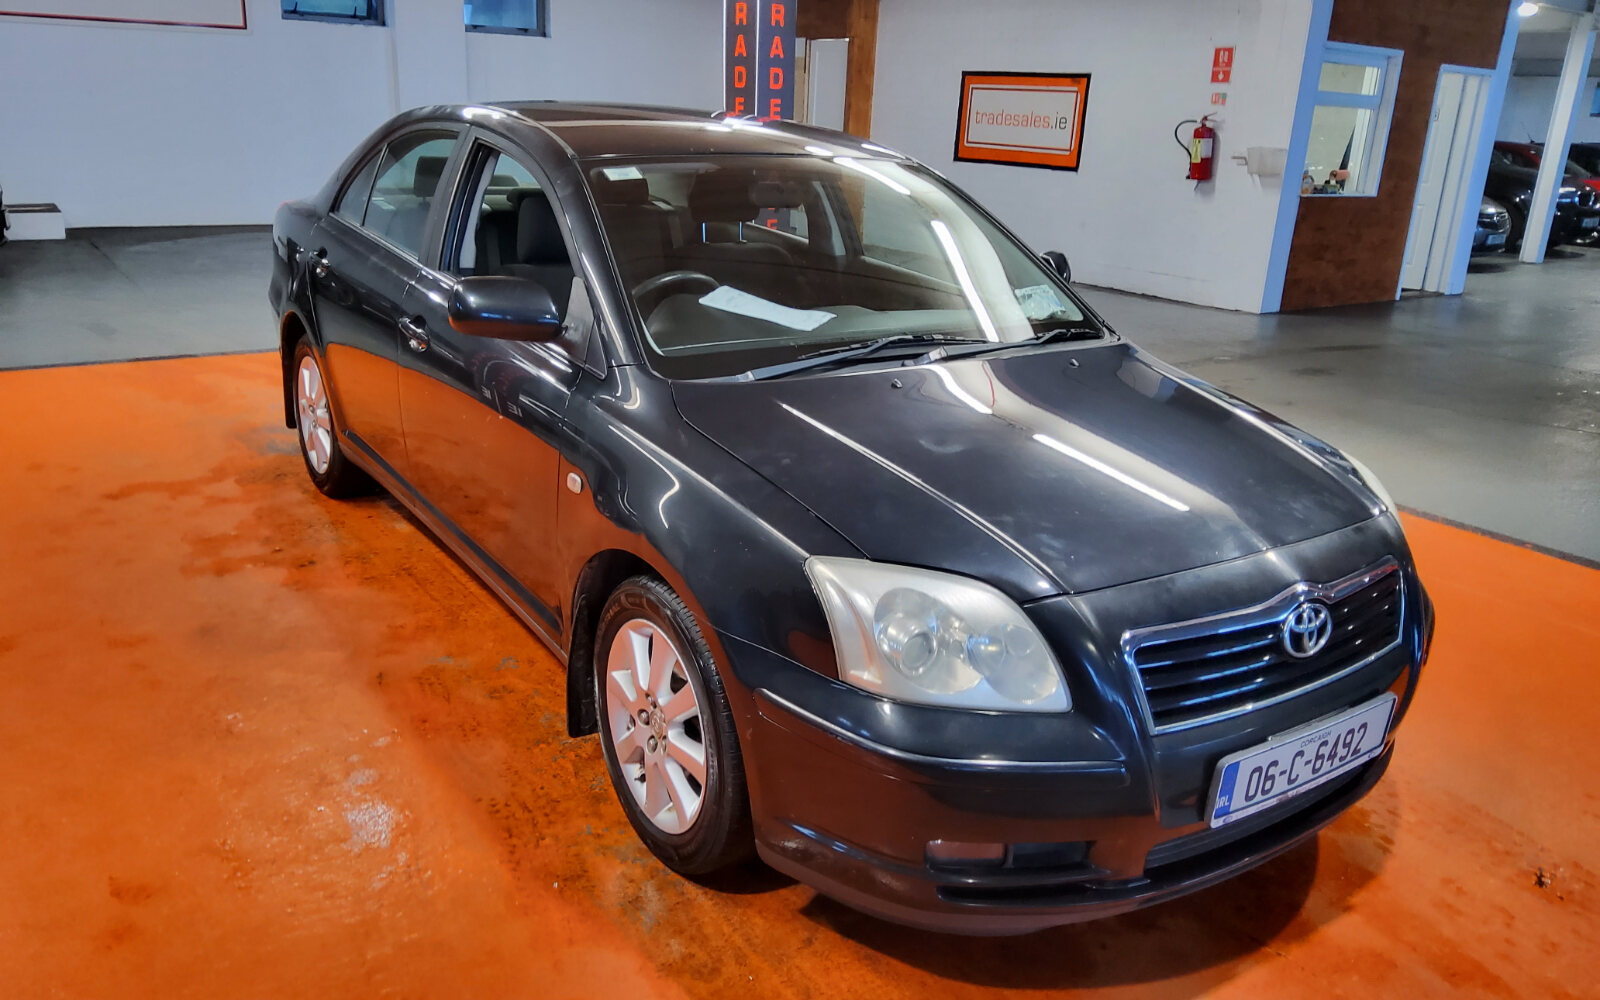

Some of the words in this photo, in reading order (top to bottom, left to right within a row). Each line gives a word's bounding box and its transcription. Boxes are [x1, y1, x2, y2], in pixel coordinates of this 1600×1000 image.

[770, 3, 784, 120] RADE
[974, 109, 1068, 130] tradesales.ie
[1244, 722, 1368, 802] 06-C-6492
